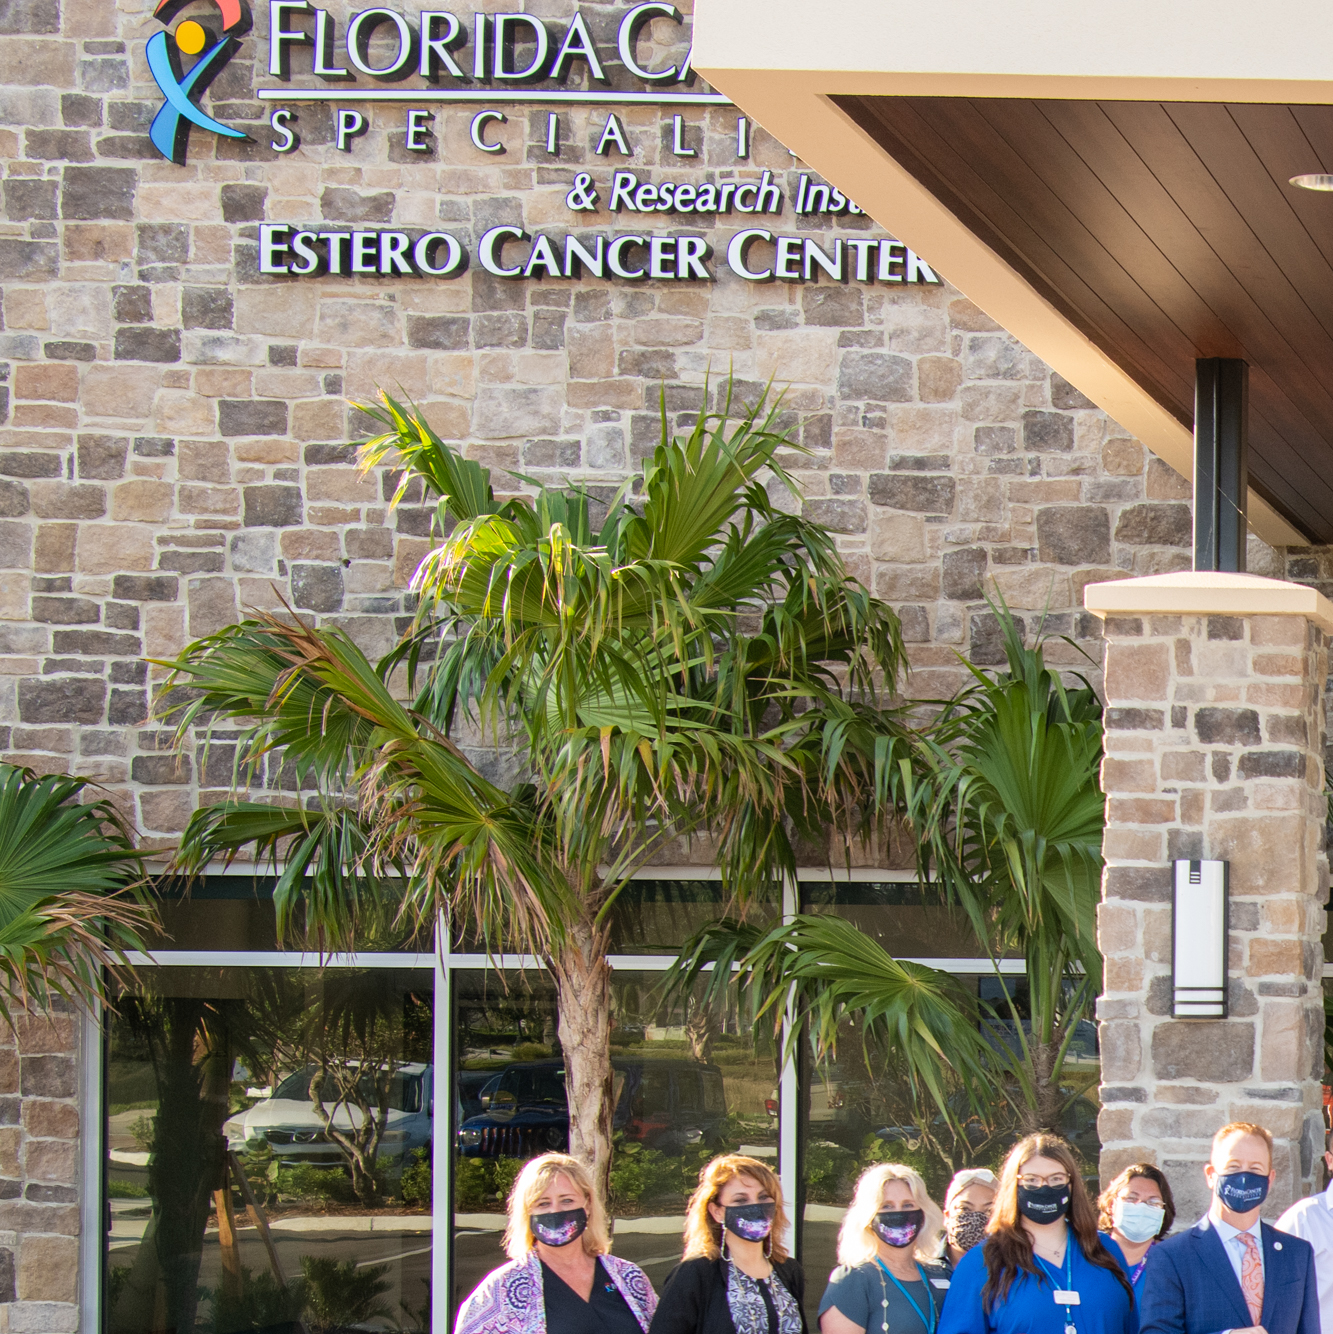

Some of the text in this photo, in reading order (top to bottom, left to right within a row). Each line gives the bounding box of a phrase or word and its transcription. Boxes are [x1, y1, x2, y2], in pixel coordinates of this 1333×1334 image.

[269, 0, 605, 79] FLORIDA
[270, 109, 798, 158] SPECIALI
[565, 172, 597, 211] &
[608, 170, 781, 213] Research
[258, 223, 463, 275] ESTERO
[479, 225, 711, 279] CANCER
